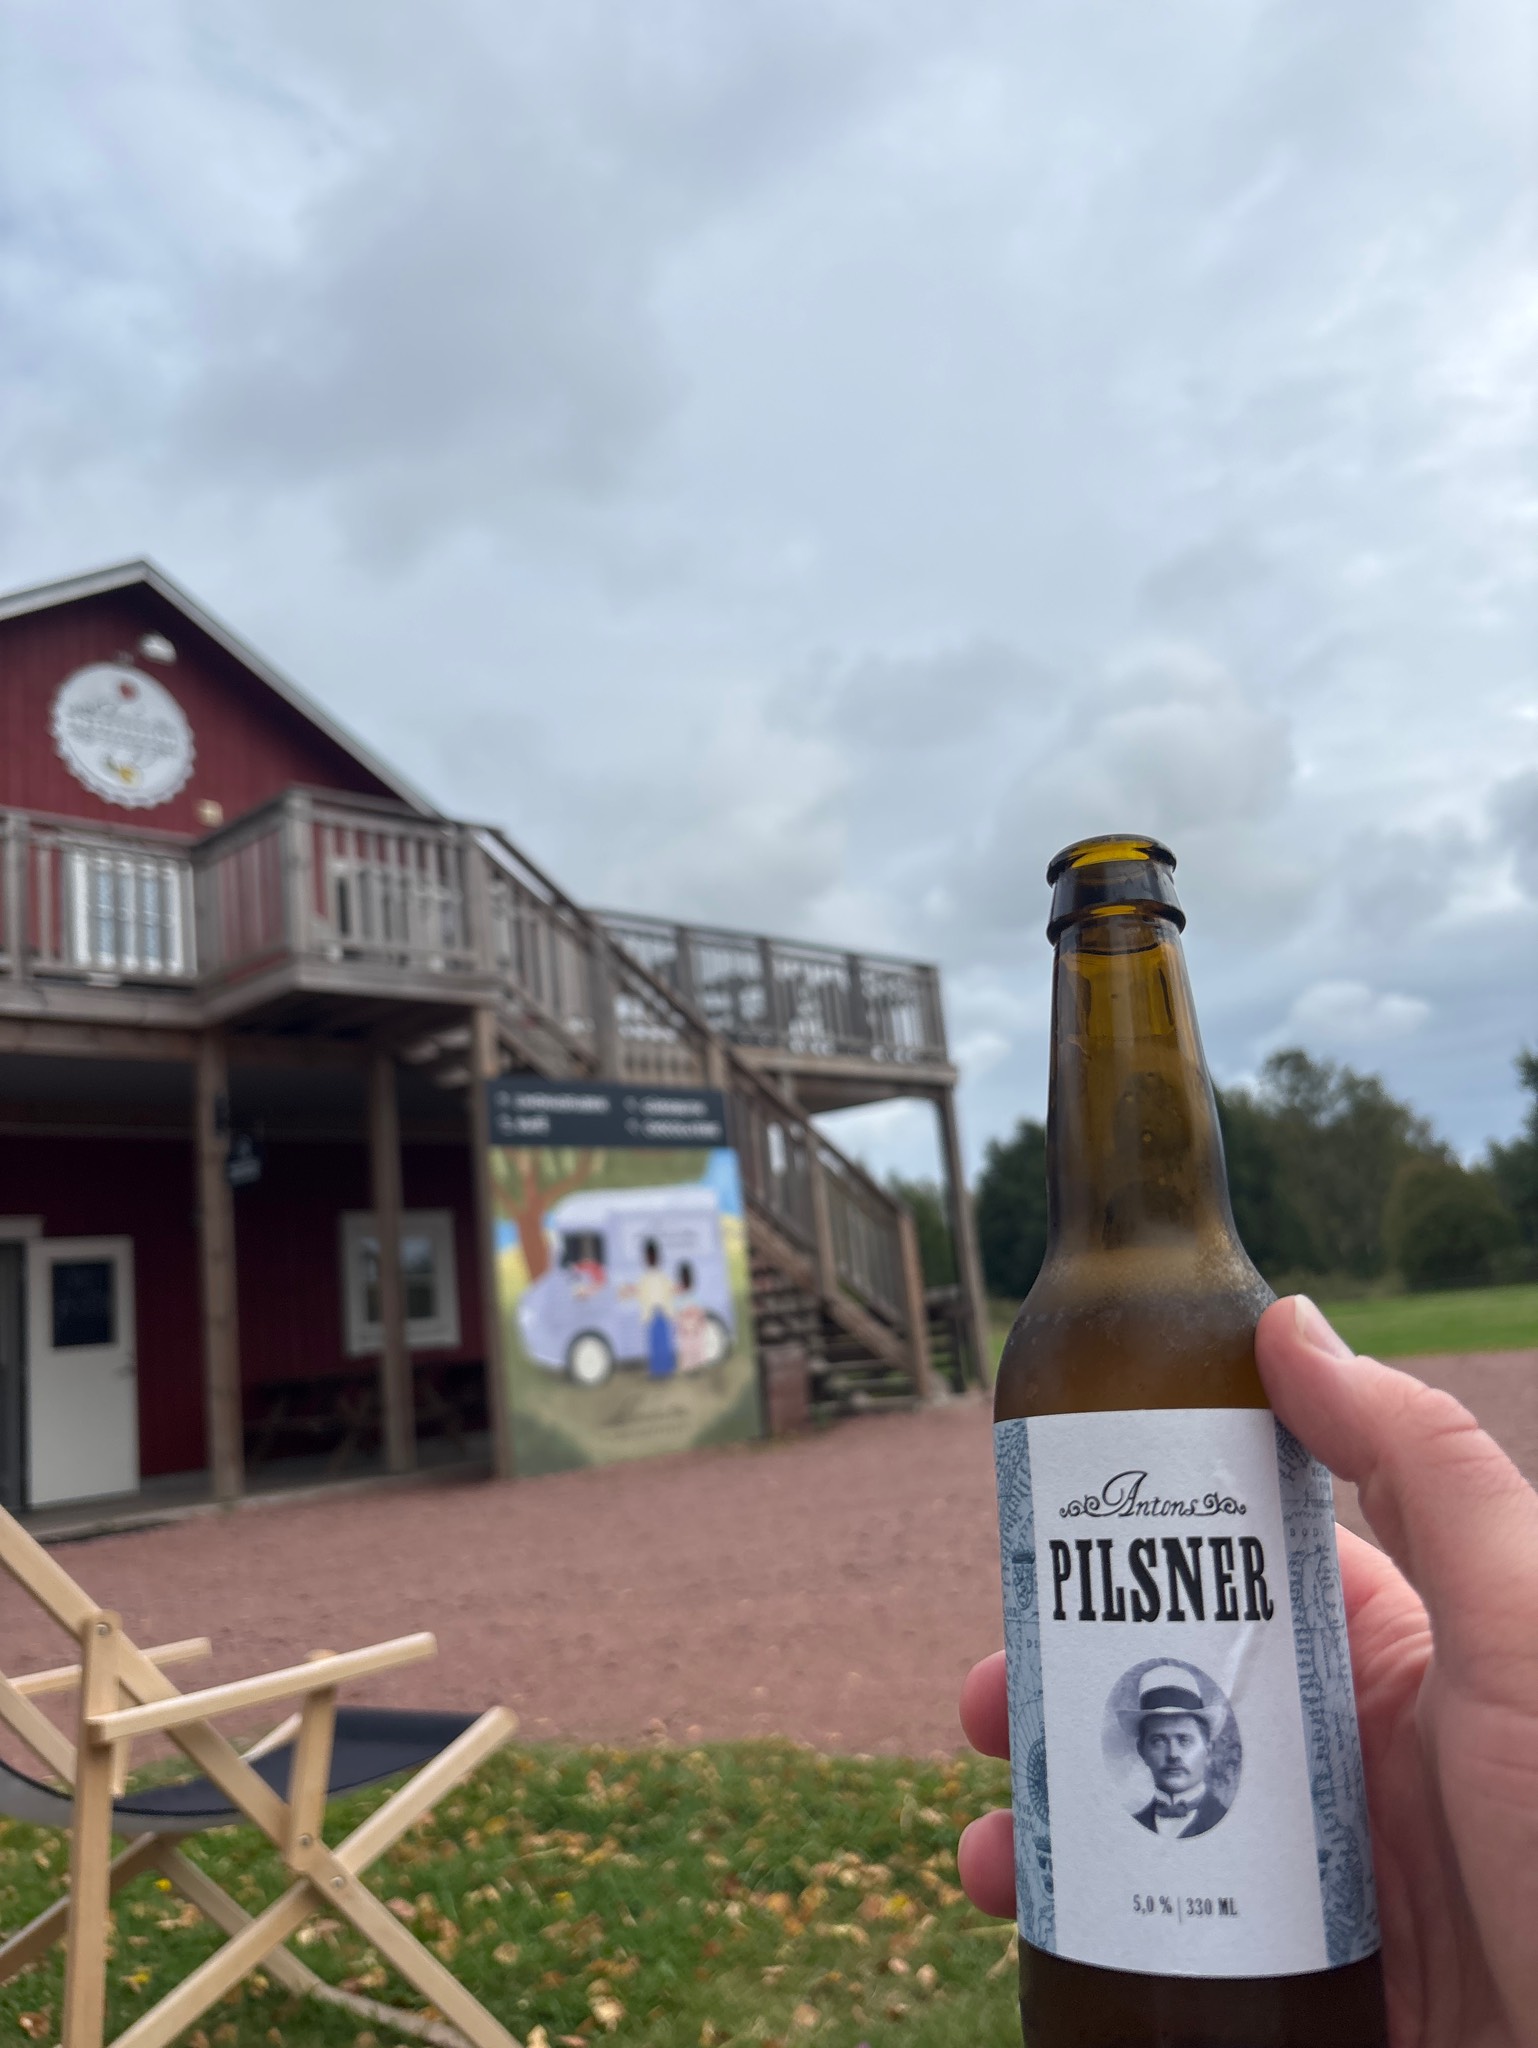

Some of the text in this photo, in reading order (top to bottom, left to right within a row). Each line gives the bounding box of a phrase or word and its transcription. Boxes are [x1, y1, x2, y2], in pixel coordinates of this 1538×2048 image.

[1086, 1470, 1217, 1518] Antons
[1049, 1536, 1274, 1622] PILSNER
[1159, 1895, 1172, 1913] %
[1186, 1897, 1212, 1916] 330
[1217, 1896, 1238, 1915] ML
